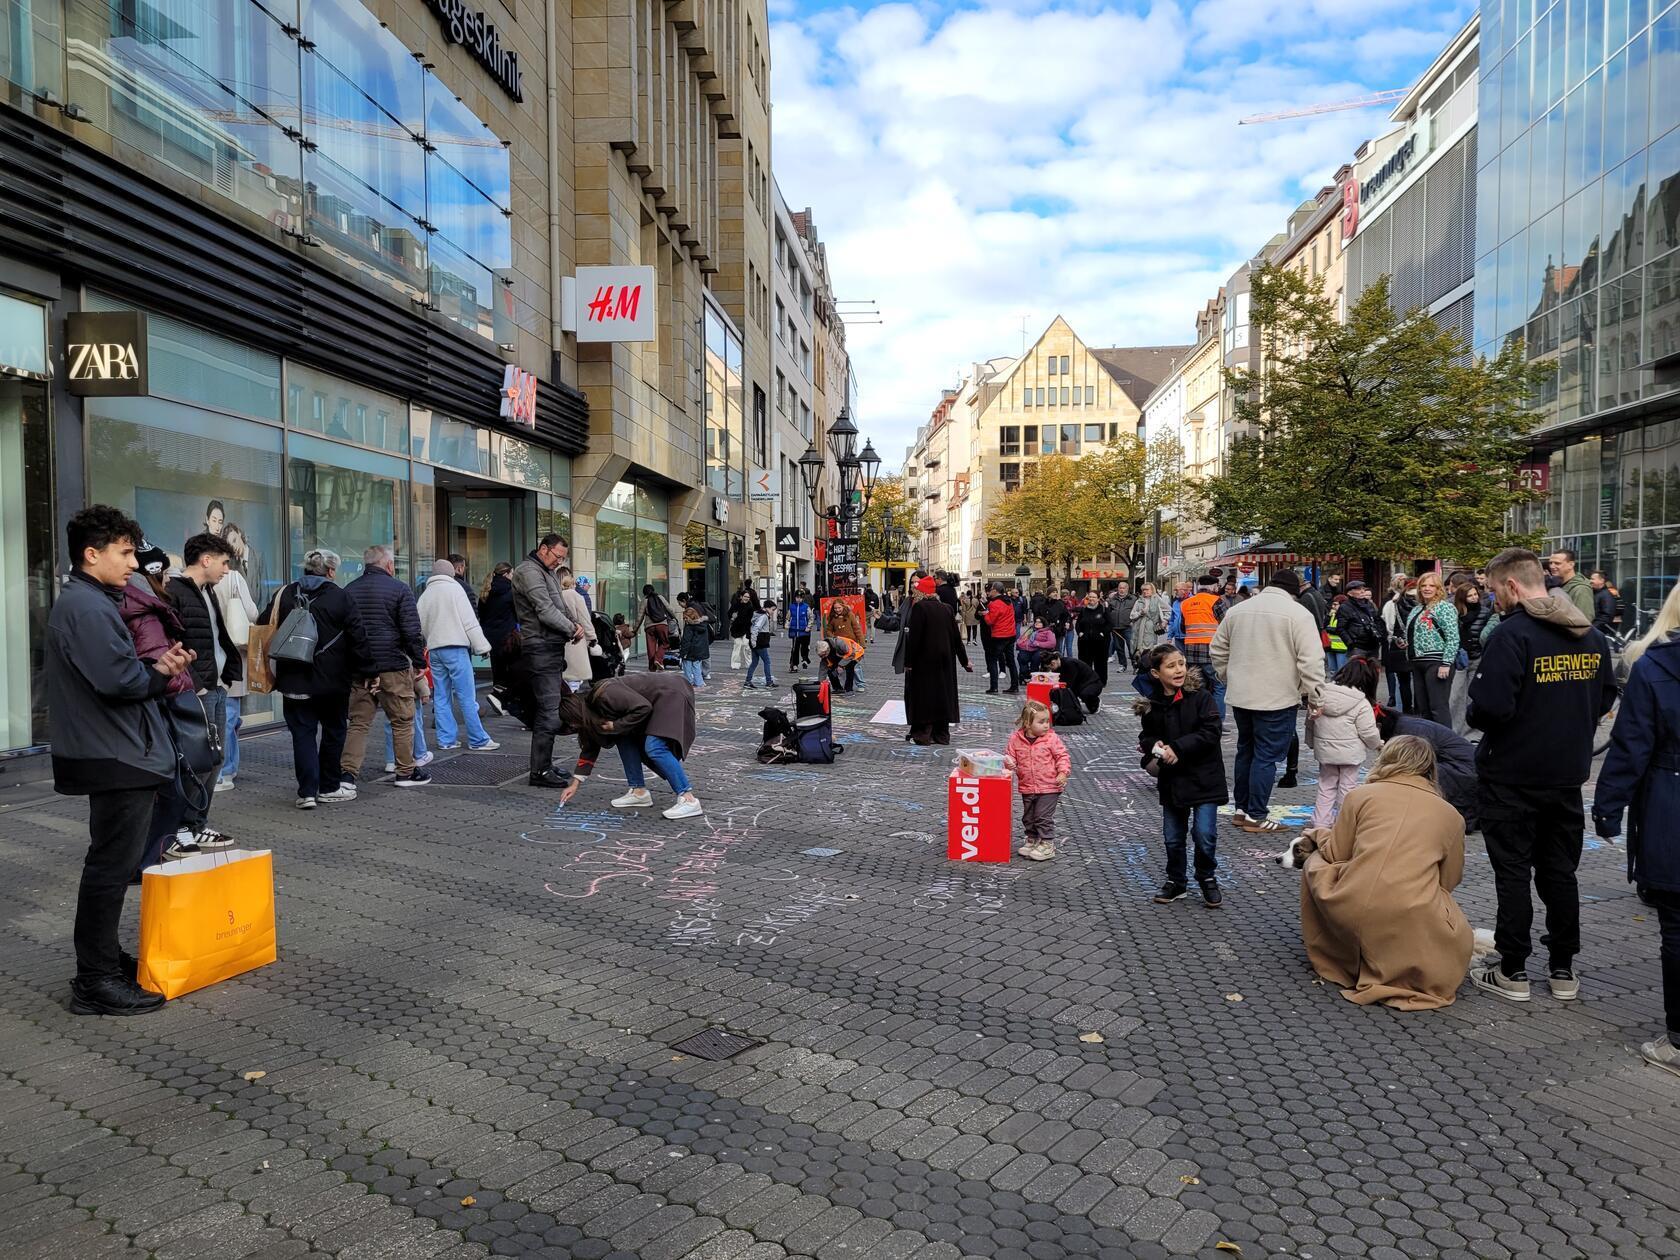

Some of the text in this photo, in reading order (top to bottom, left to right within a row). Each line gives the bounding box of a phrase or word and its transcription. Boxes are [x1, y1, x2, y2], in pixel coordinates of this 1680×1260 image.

[588, 285, 641, 322] H&M
[68, 342, 139, 380] ZARA
[832, 563, 857, 573] GESPART
[833, 554, 846, 563] HAT
[1534, 653, 1602, 673] FEUERWEHR
[1536, 669, 1598, 683] MARKT FEUCHT
[956, 778, 980, 860] ver.di
